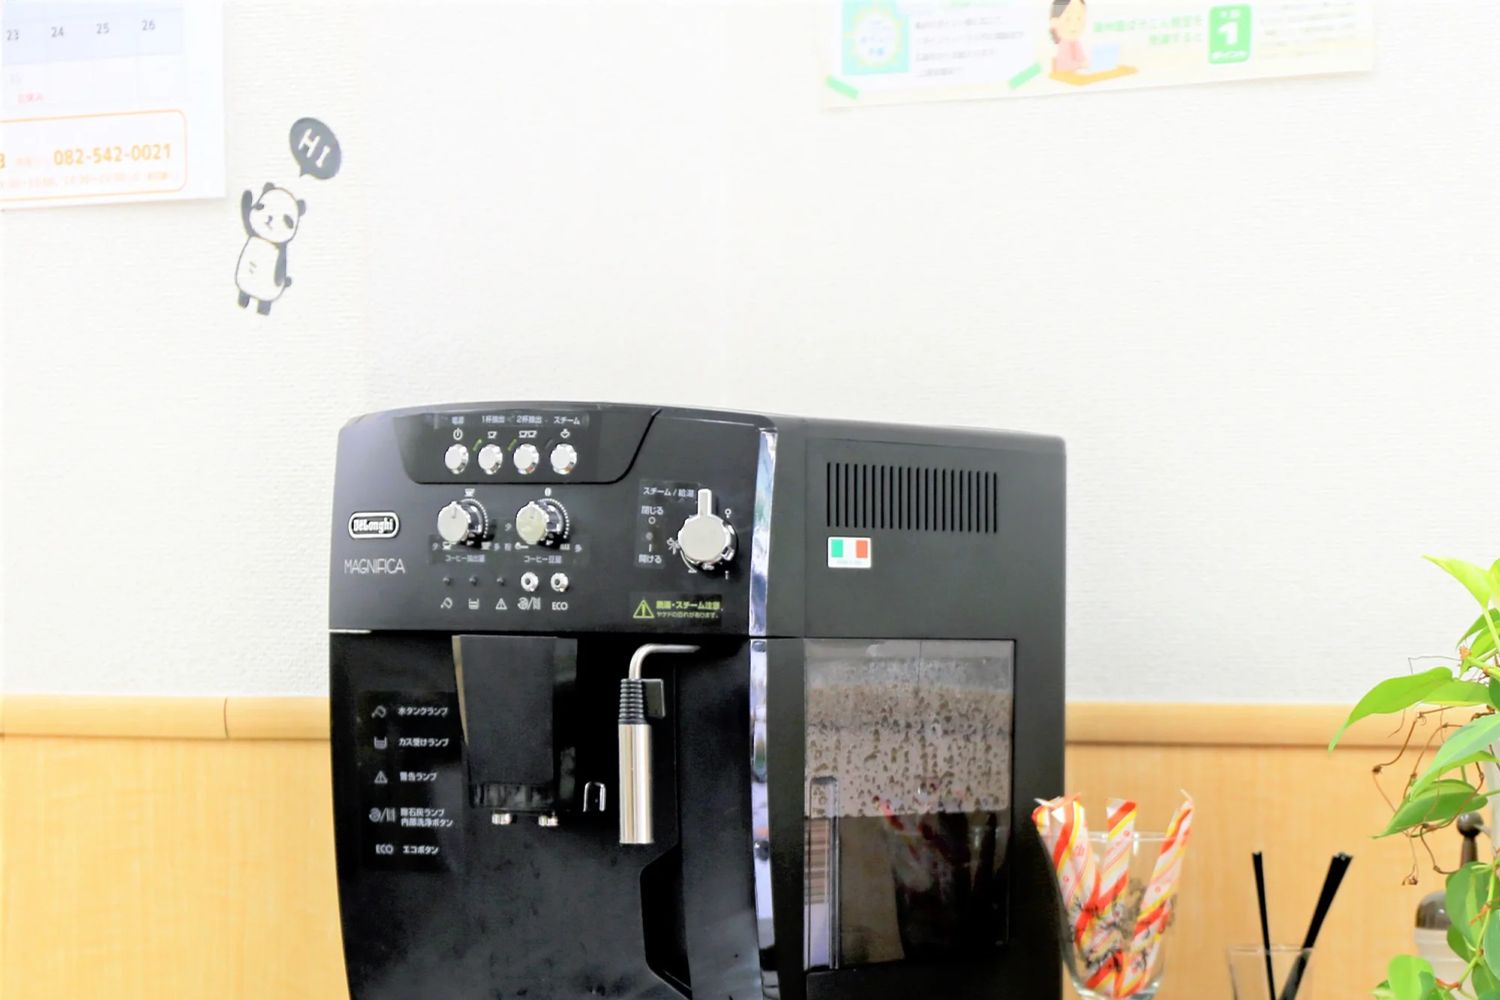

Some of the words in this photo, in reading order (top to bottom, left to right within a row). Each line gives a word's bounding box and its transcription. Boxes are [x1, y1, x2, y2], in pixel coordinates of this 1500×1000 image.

[6, 29, 20, 41] 23
[51, 26, 65, 38] 24
[96, 22, 110, 34] 25
[141, 19, 156, 31] 26
[298, 127, 331, 168] HI
[53, 143, 172, 166] 082-542-0021
[553, 416, 581, 425] スチーム
[344, 558, 406, 574] MAGNIFICA
[552, 601, 568, 611] ECO
[397, 706, 448, 717] 水タンクランプ
[376, 844, 394, 855] ECO
[403, 845, 438, 855] エコボタン
